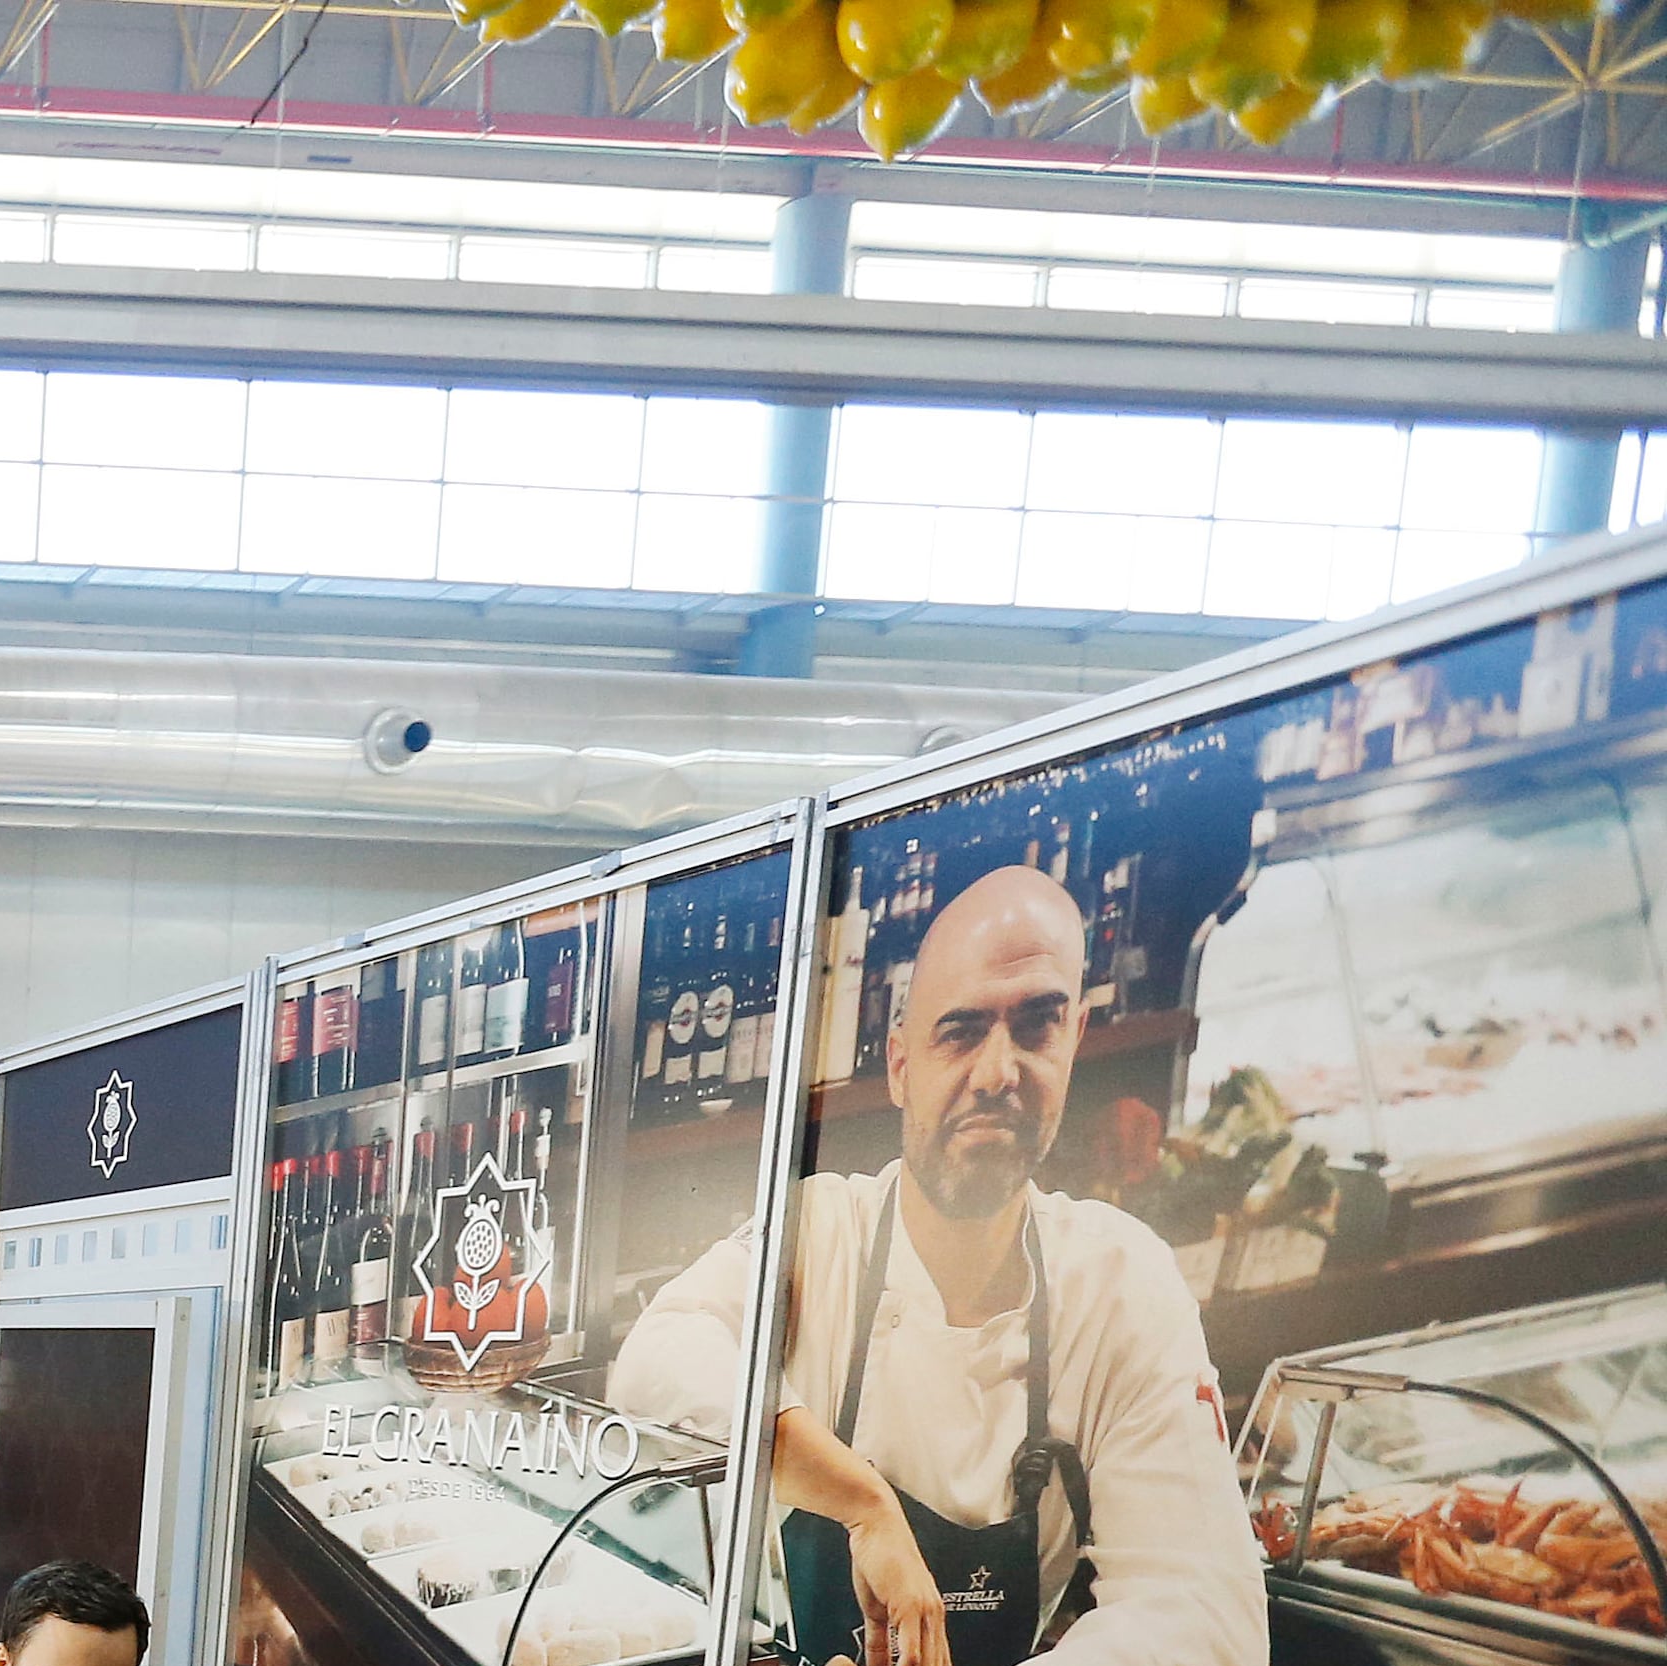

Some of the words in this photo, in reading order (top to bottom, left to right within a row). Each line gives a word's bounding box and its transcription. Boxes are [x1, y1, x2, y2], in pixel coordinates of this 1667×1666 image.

[321, 1401, 362, 1459] EL
[369, 1399, 640, 1481] GRANAÍNO
[407, 1477, 461, 1501] DESDE
[466, 1481, 507, 1504] 1964
